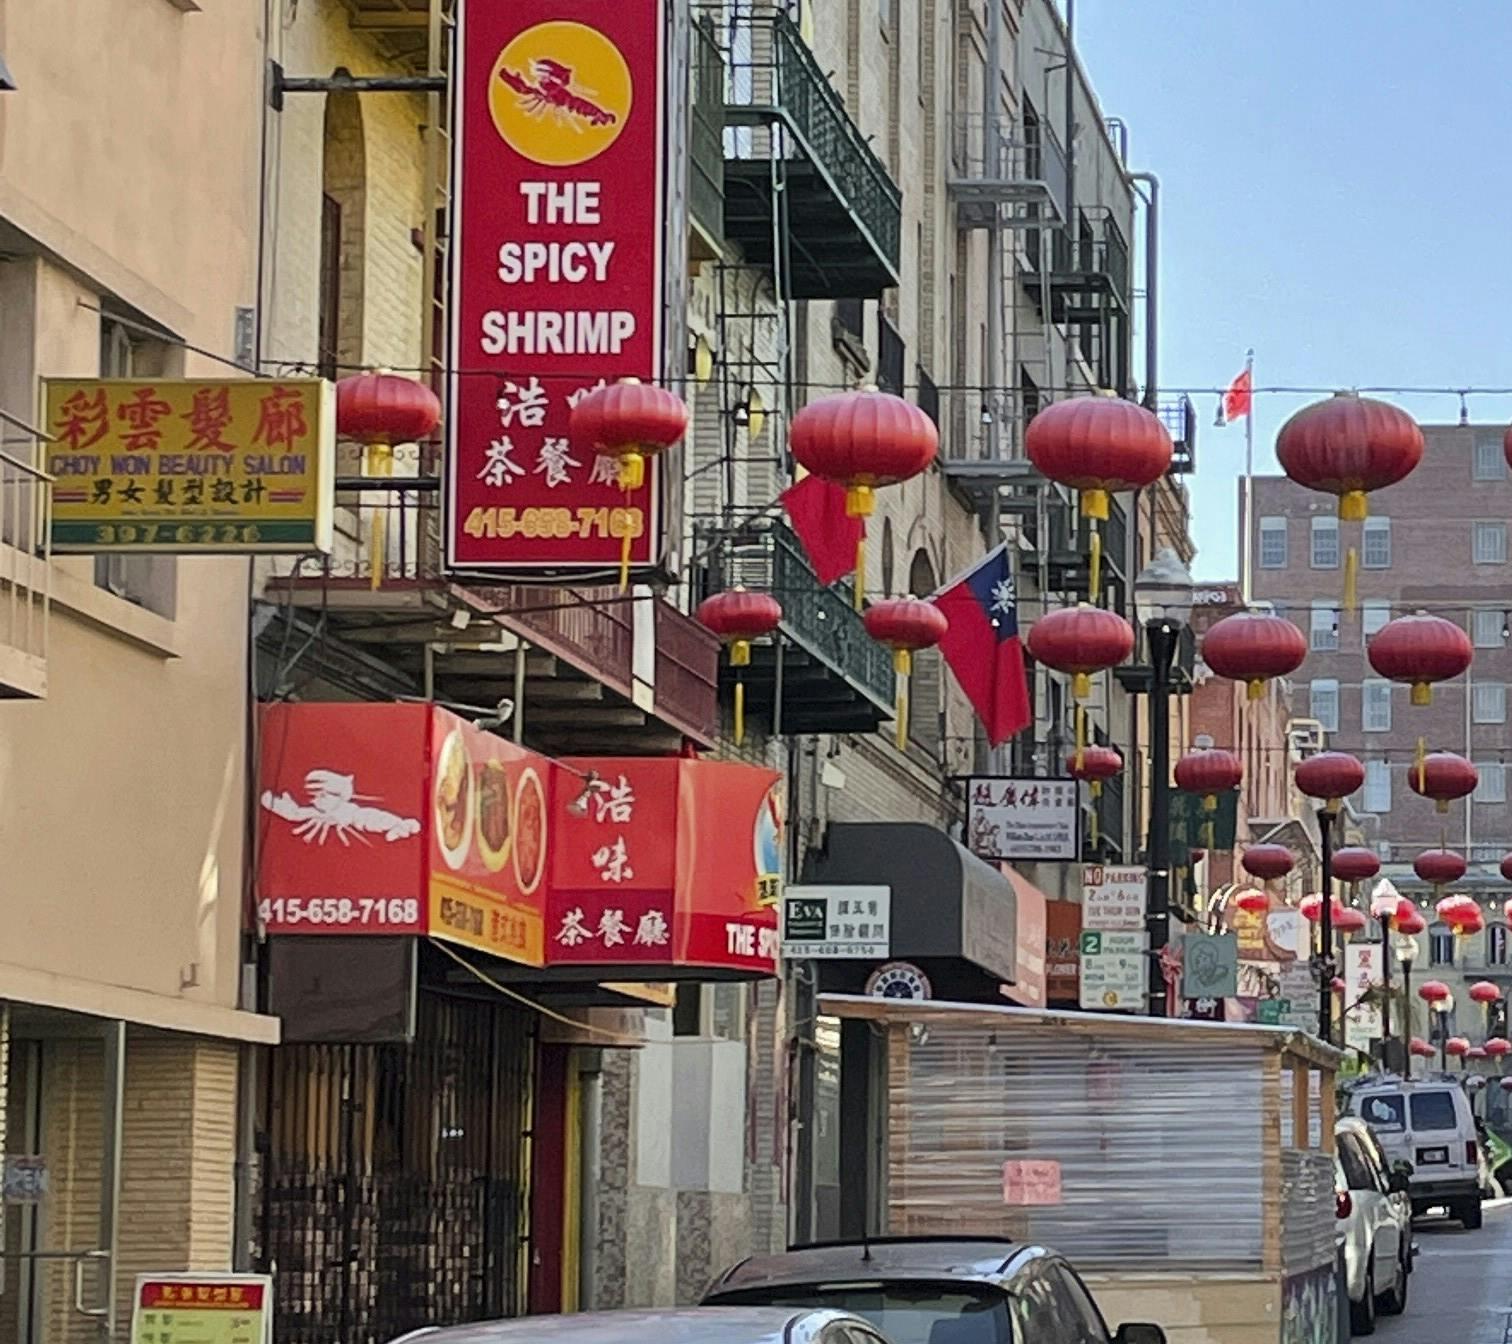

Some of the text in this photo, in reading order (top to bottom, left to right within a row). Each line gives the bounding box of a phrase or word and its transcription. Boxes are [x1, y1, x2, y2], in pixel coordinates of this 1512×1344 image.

[520, 182, 600, 224] THE
[498, 242, 615, 283] SPICY
[481, 312, 635, 354] SHRIMP
[54, 385, 307, 452] 彩雲髮廊
[500, 377, 607, 427] 浩
[111, 455, 150, 475] WON
[159, 455, 233, 475] BEAUTY
[245, 455, 306, 475] SALON
[258, 897, 418, 924] 415-658-7168
[555, 907, 670, 947] 茶餐廳
[726, 923, 756, 956] THE
[1085, 936, 1098, 953] 2
